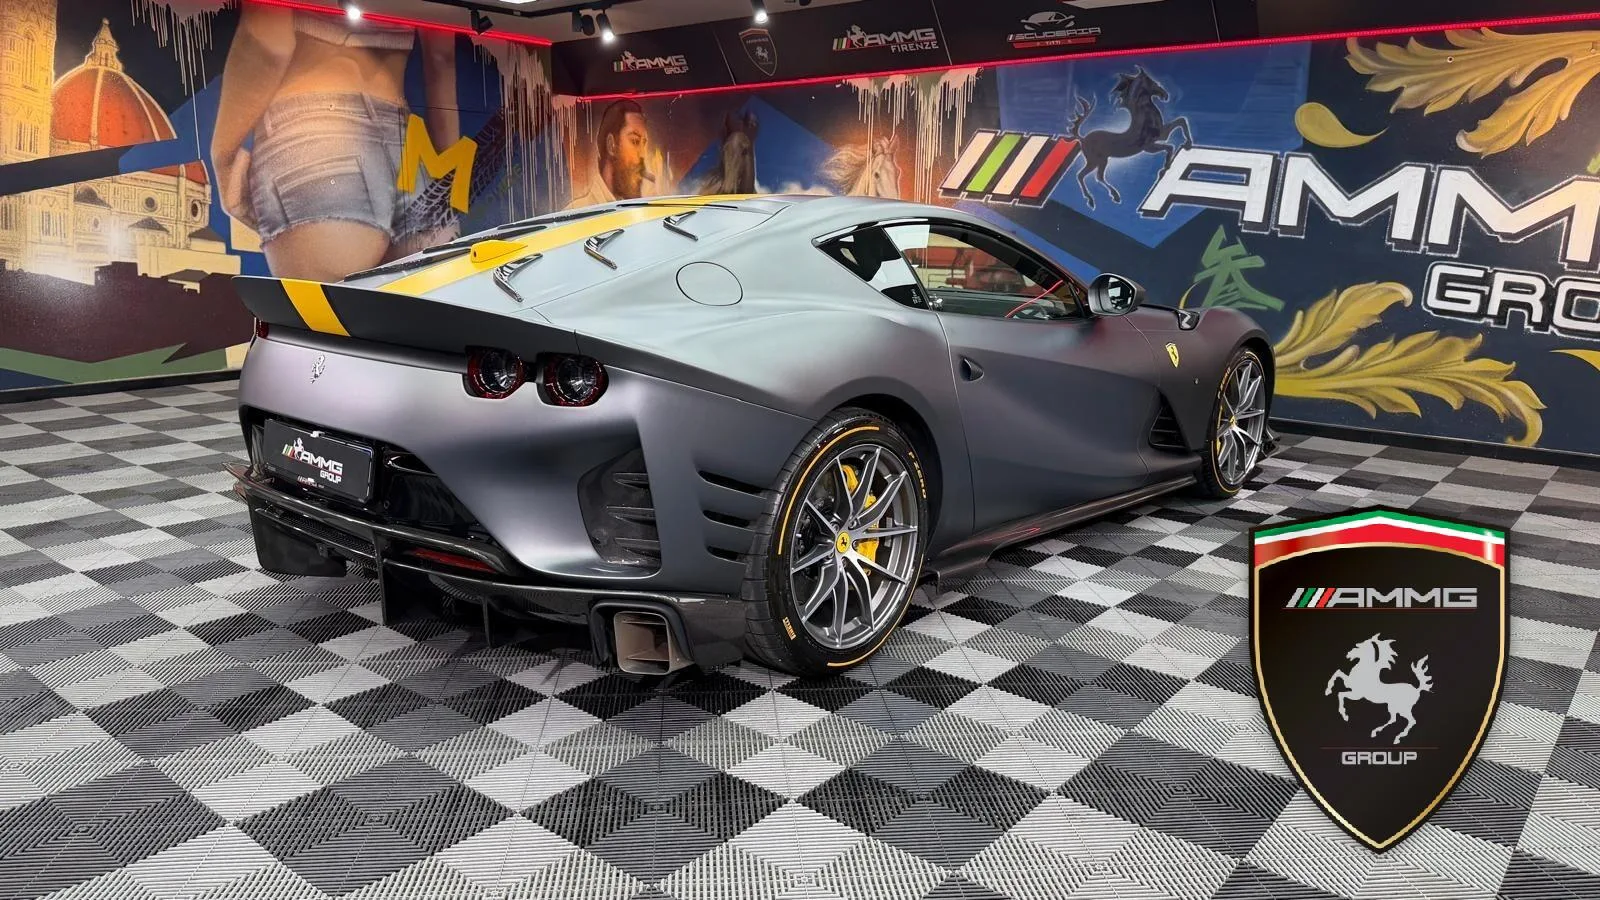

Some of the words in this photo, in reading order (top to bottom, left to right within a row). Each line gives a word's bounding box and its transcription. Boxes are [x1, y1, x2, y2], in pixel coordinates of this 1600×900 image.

[864, 27, 936, 47] AMMG
[890, 40, 939, 53] FIRENZE
[635, 54, 687, 71] AMMG
[664, 65, 689, 75] GROUP
[299, 451, 343, 475] AMMG
[320, 470, 342, 484] GROUP
